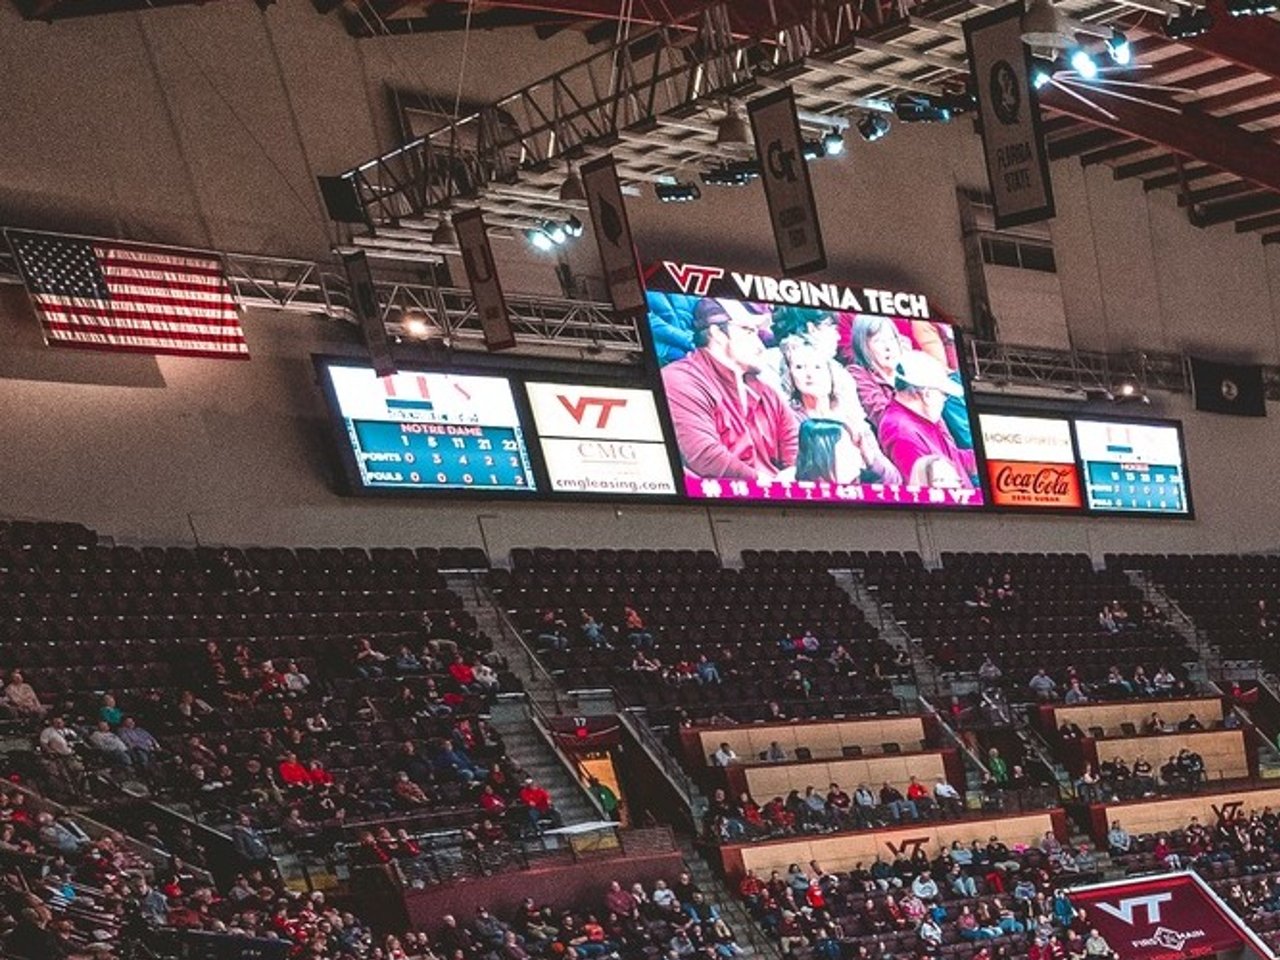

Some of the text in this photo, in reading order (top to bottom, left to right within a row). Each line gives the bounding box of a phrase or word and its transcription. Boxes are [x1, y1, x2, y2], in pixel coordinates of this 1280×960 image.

[663, 261, 930, 318] VT VIRGINIA TECH
[556, 395, 628, 429] VT
[401, 424, 483, 437] NOTRE DAME
[577, 442, 638, 462] CMG
[556, 477, 672, 492] cmgleasing.com
[996, 466, 1070, 496] Coca-Cola
[573, 717, 586, 727] 17
[1095, 892, 1172, 925] VT
[1178, 929, 1205, 940] MAIN
